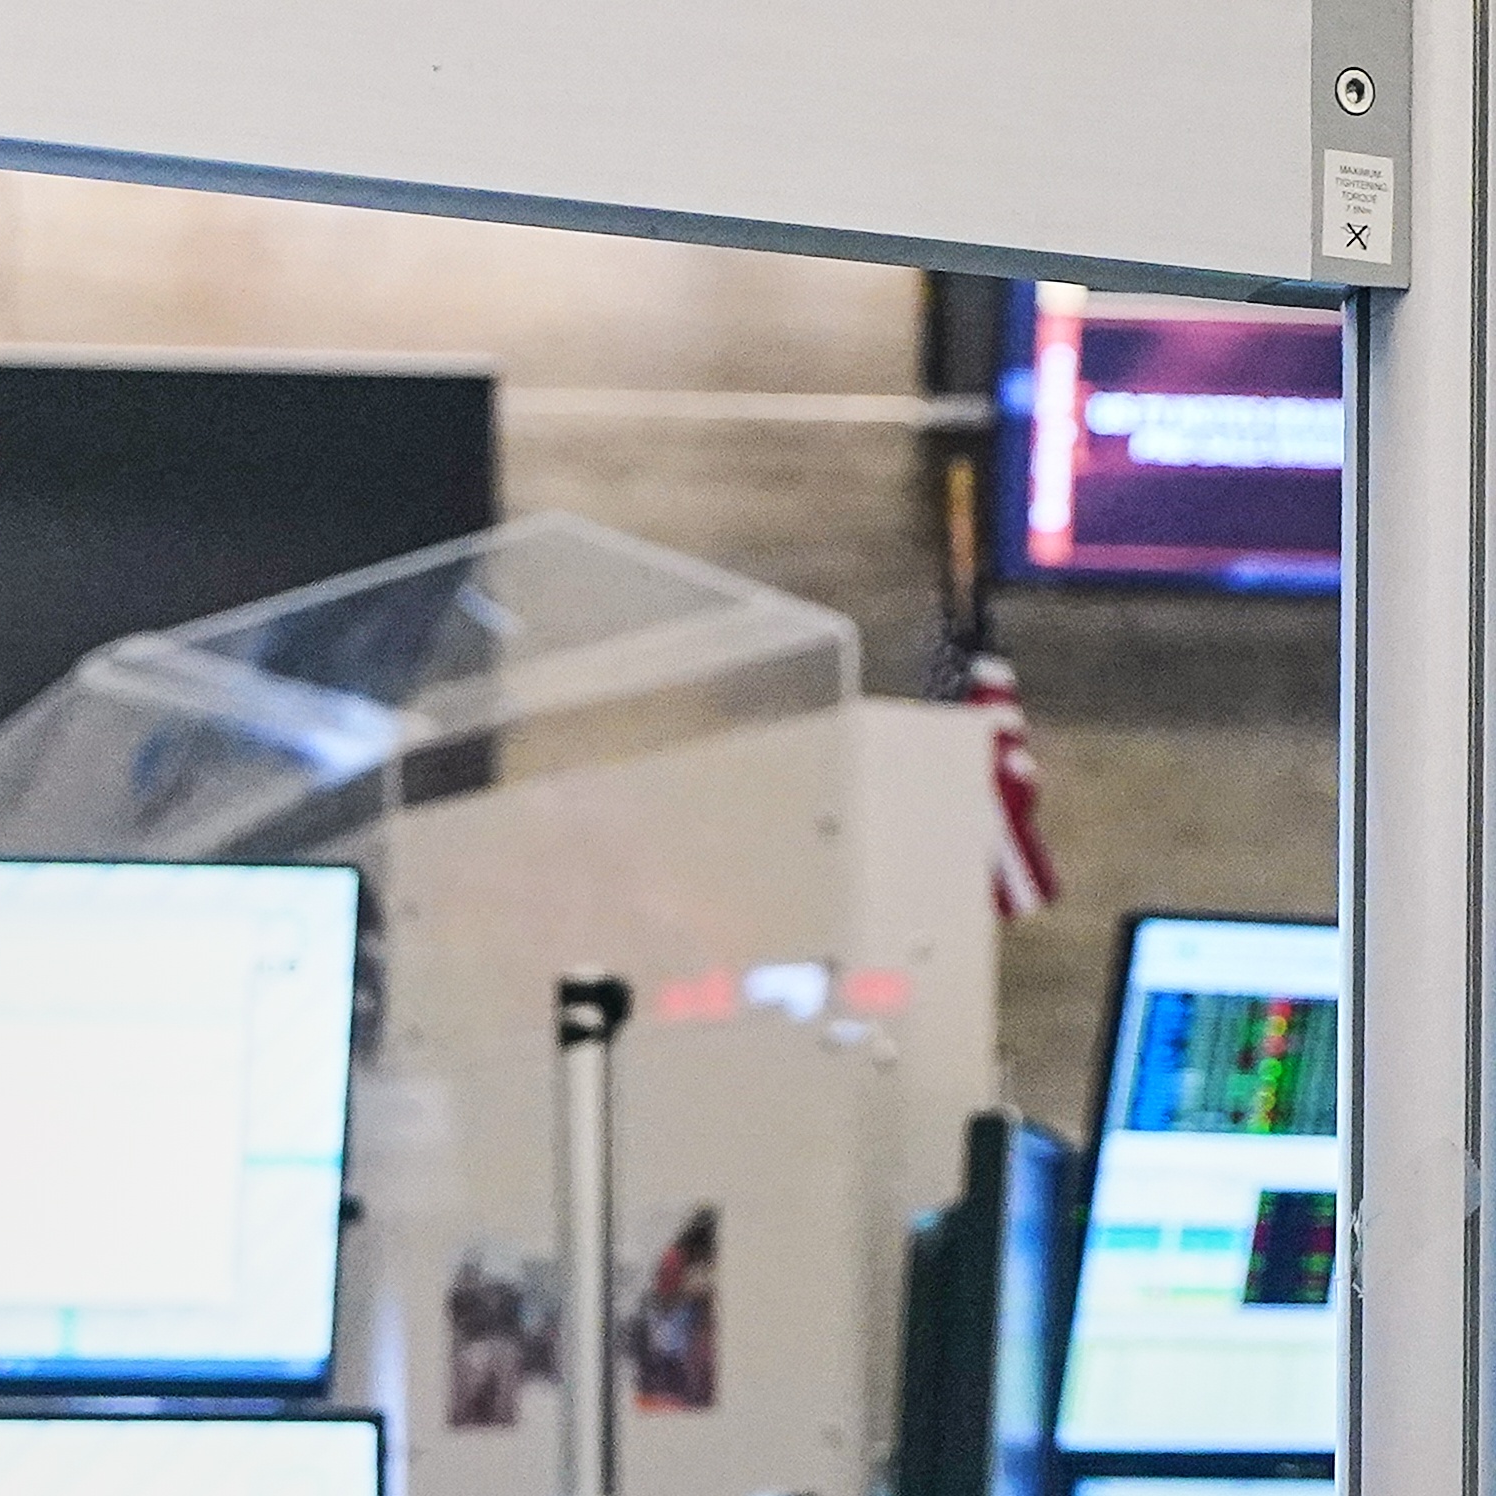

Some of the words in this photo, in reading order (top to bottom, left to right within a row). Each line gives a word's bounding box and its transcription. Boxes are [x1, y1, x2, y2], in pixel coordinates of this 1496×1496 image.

[1339, 165, 1383, 181] MAXIMUM
[1335, 176, 1388, 193] TIGHTENING
[1341, 189, 1378, 205] TORQUE
